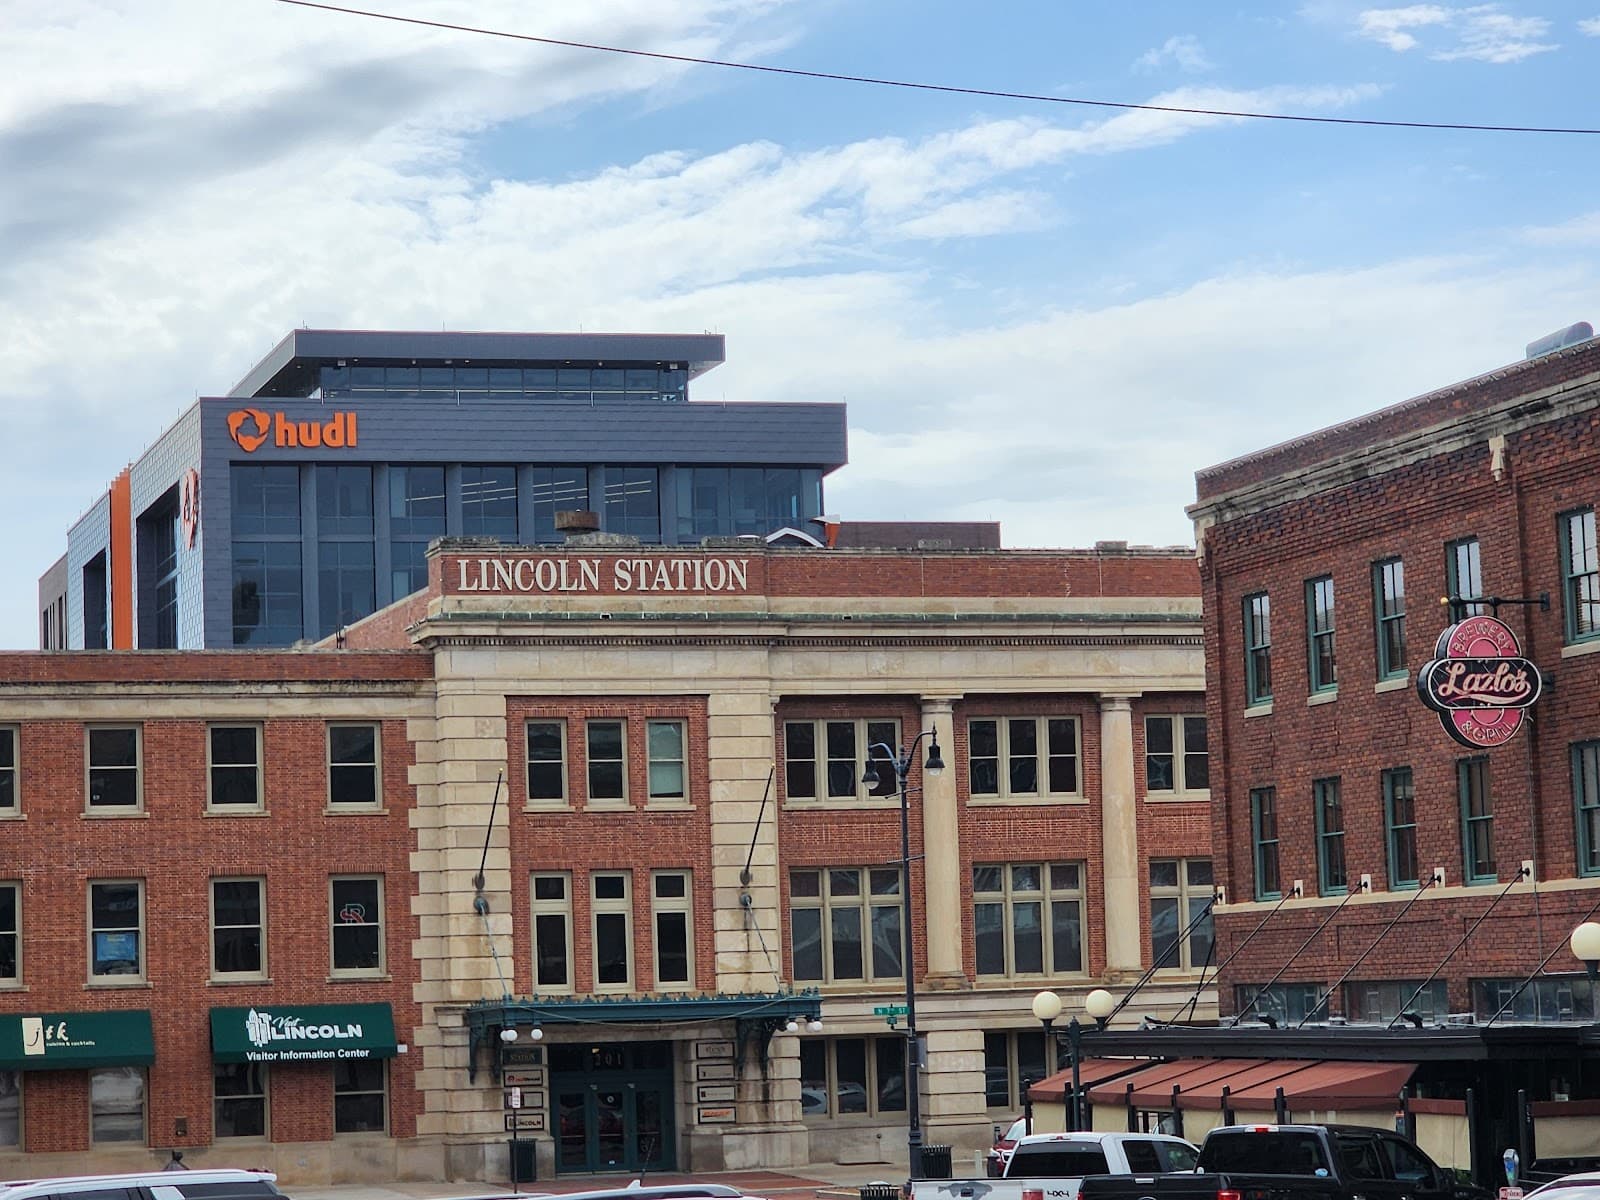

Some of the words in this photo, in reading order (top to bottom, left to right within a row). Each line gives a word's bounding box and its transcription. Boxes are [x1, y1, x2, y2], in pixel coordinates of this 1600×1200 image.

[274, 410, 358, 448] hudl
[457, 558, 601, 592] LINCOLN
[614, 558, 749, 592] STATION
[1453, 624, 1512, 652] BREWERY
[1438, 662, 1532, 704] Lazlo's
[271, 1024, 363, 1040] LINCOLN
[246, 1051, 278, 1061] Visitor
[280, 1050, 335, 1060] Information
[337, 1048, 370, 1058] Center
